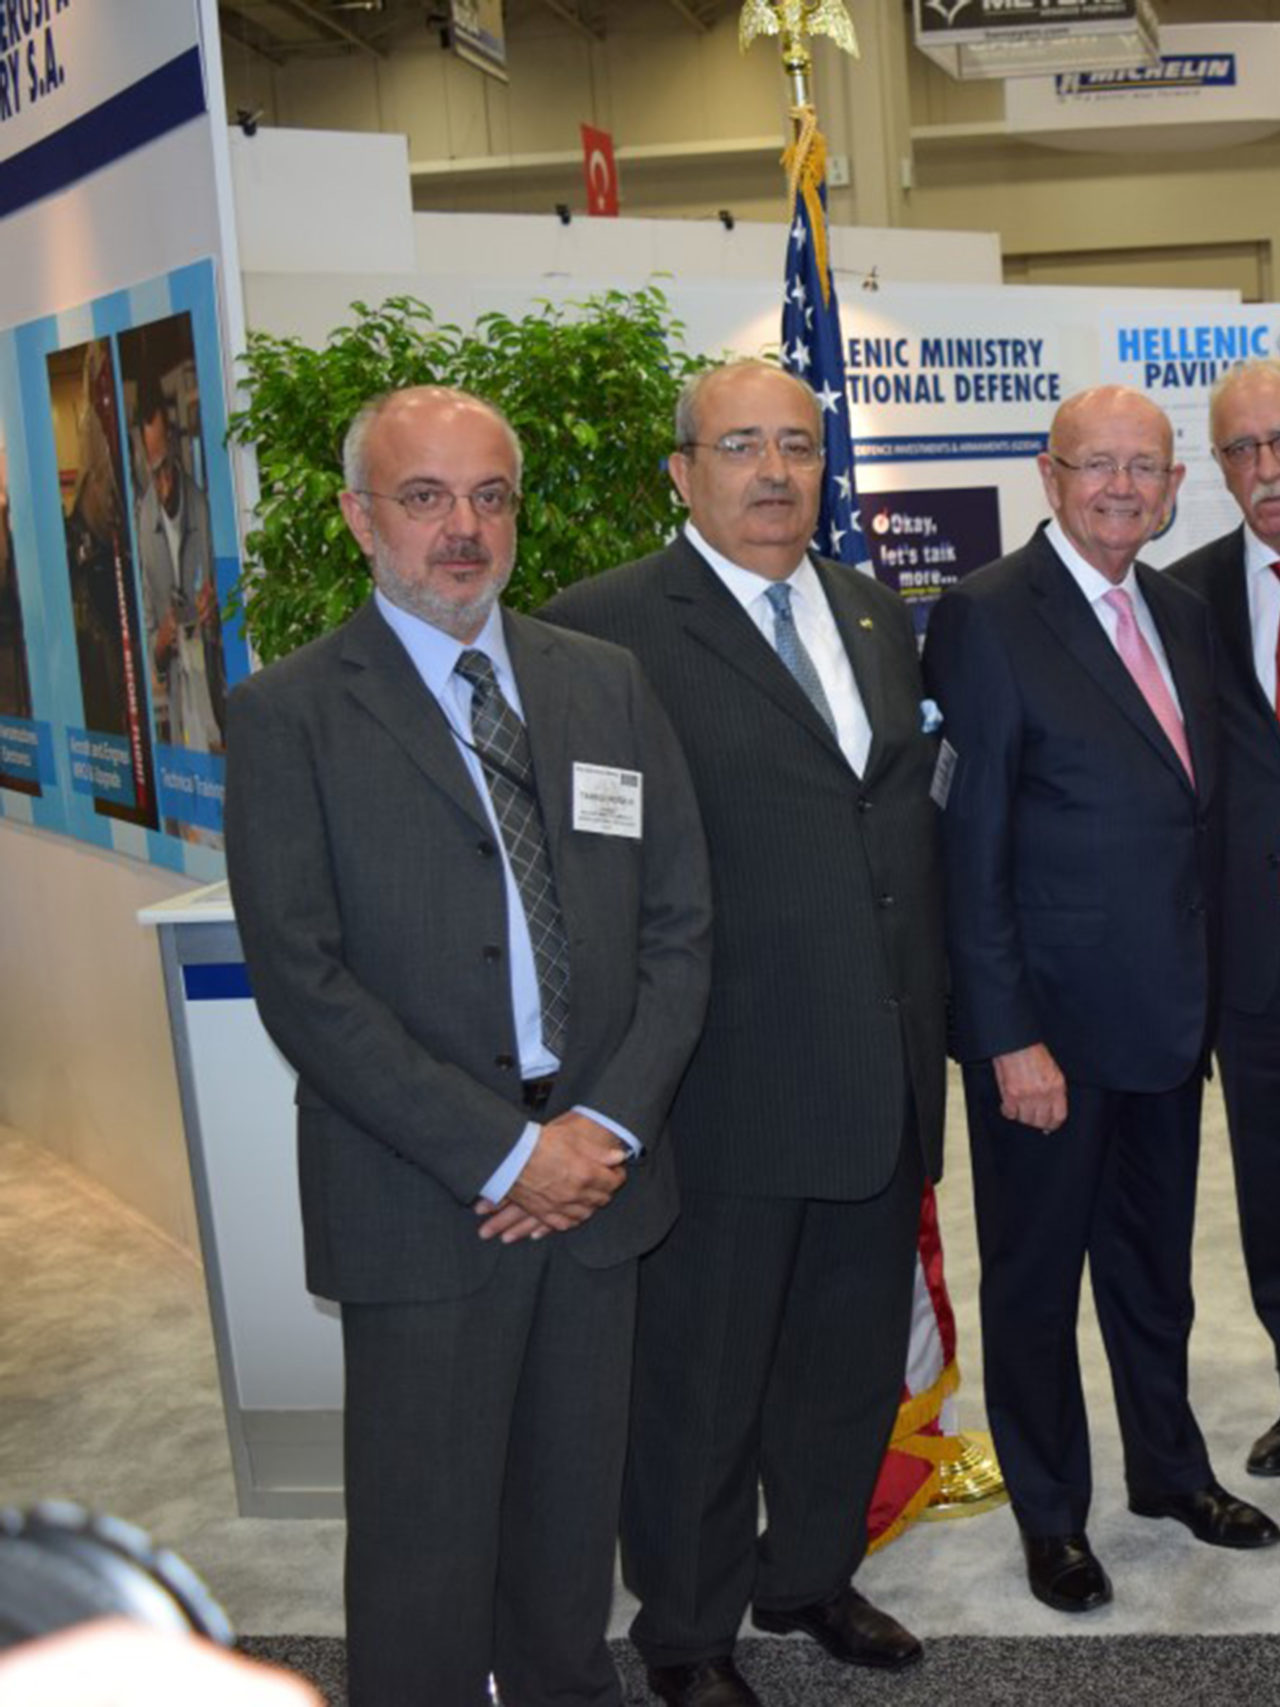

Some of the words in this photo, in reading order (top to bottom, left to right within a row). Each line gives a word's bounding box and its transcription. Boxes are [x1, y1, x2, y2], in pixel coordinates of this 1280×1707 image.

[27, 26, 65, 103] S.A.
[1089, 59, 1230, 82] MICHELIN
[844, 337, 909, 368] ENIC
[920, 337, 1043, 368] MINISTRY
[1118, 325, 1269, 362] HELLENIC
[847, 373, 945, 404] TIONAL
[954, 372, 1061, 402] DEFENCE
[890, 513, 937, 536] Okay,
[880, 544, 918, 566] let's
[923, 543, 957, 563] talk
